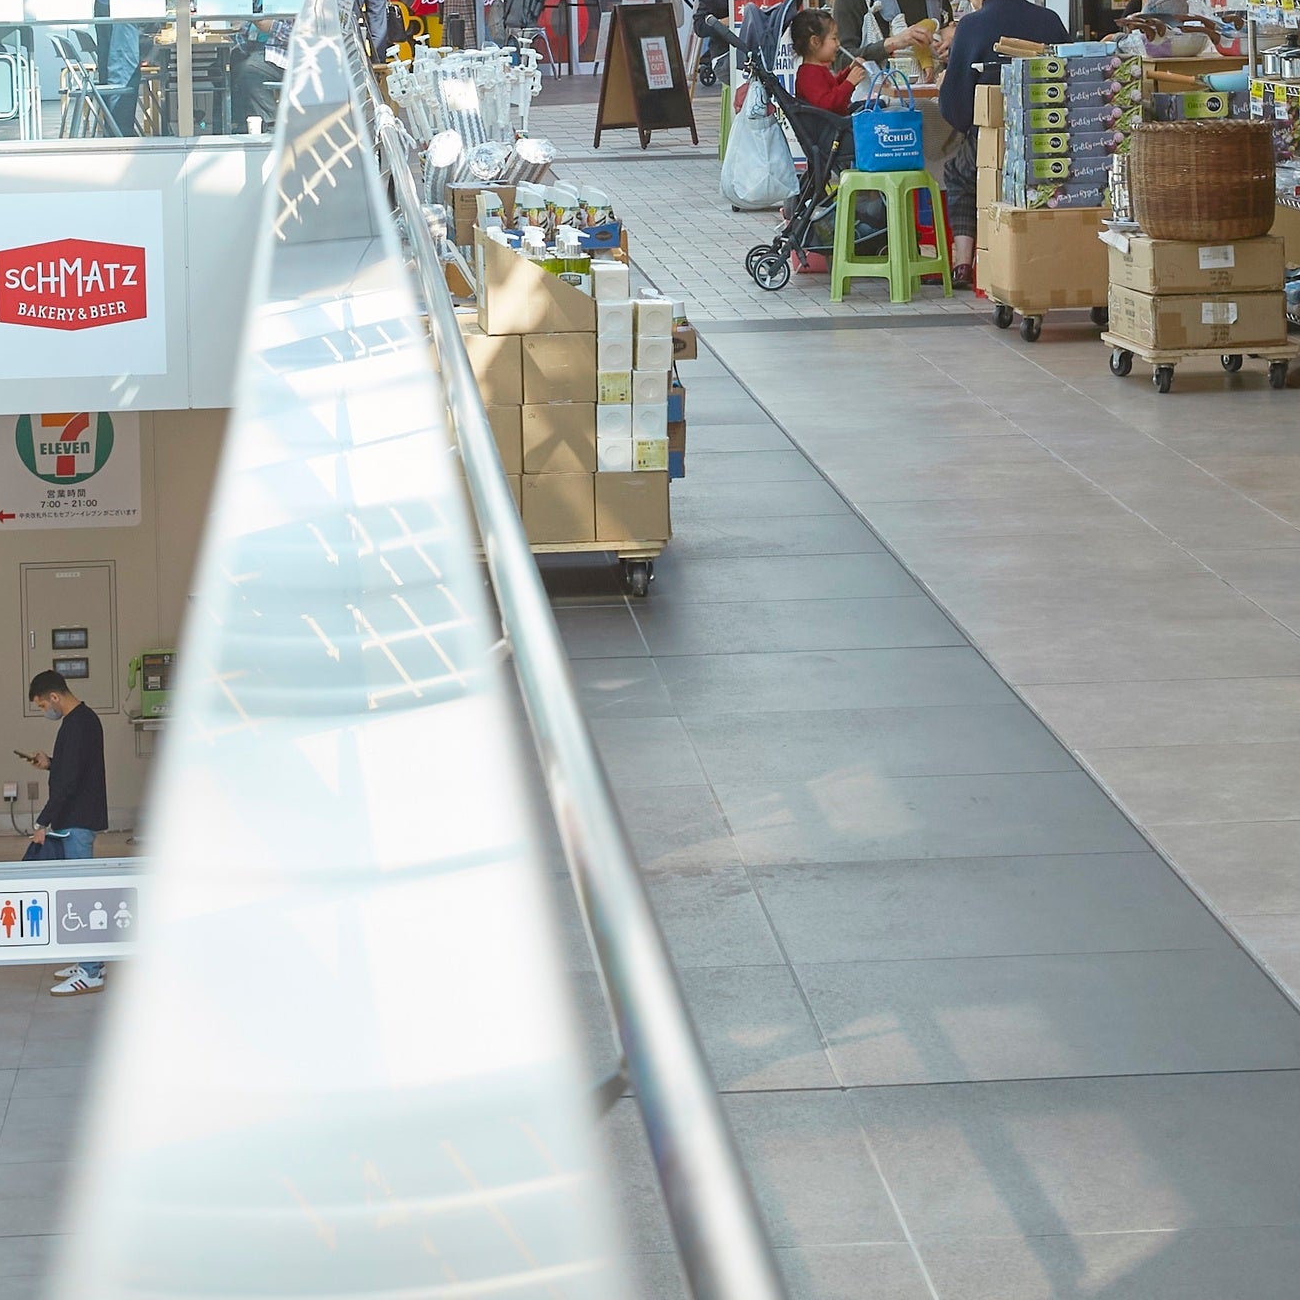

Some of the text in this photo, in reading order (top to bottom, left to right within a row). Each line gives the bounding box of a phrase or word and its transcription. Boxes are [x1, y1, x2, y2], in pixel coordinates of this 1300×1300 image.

[650, 62, 665, 71] OUT
[4, 257, 138, 298] SCHMATZ
[17, 301, 75, 322] BAKERY
[89, 300, 127, 320] BEER
[46, 488, 87, 499] 営業時間
[40, 499, 98, 509] 7:00 21:00
